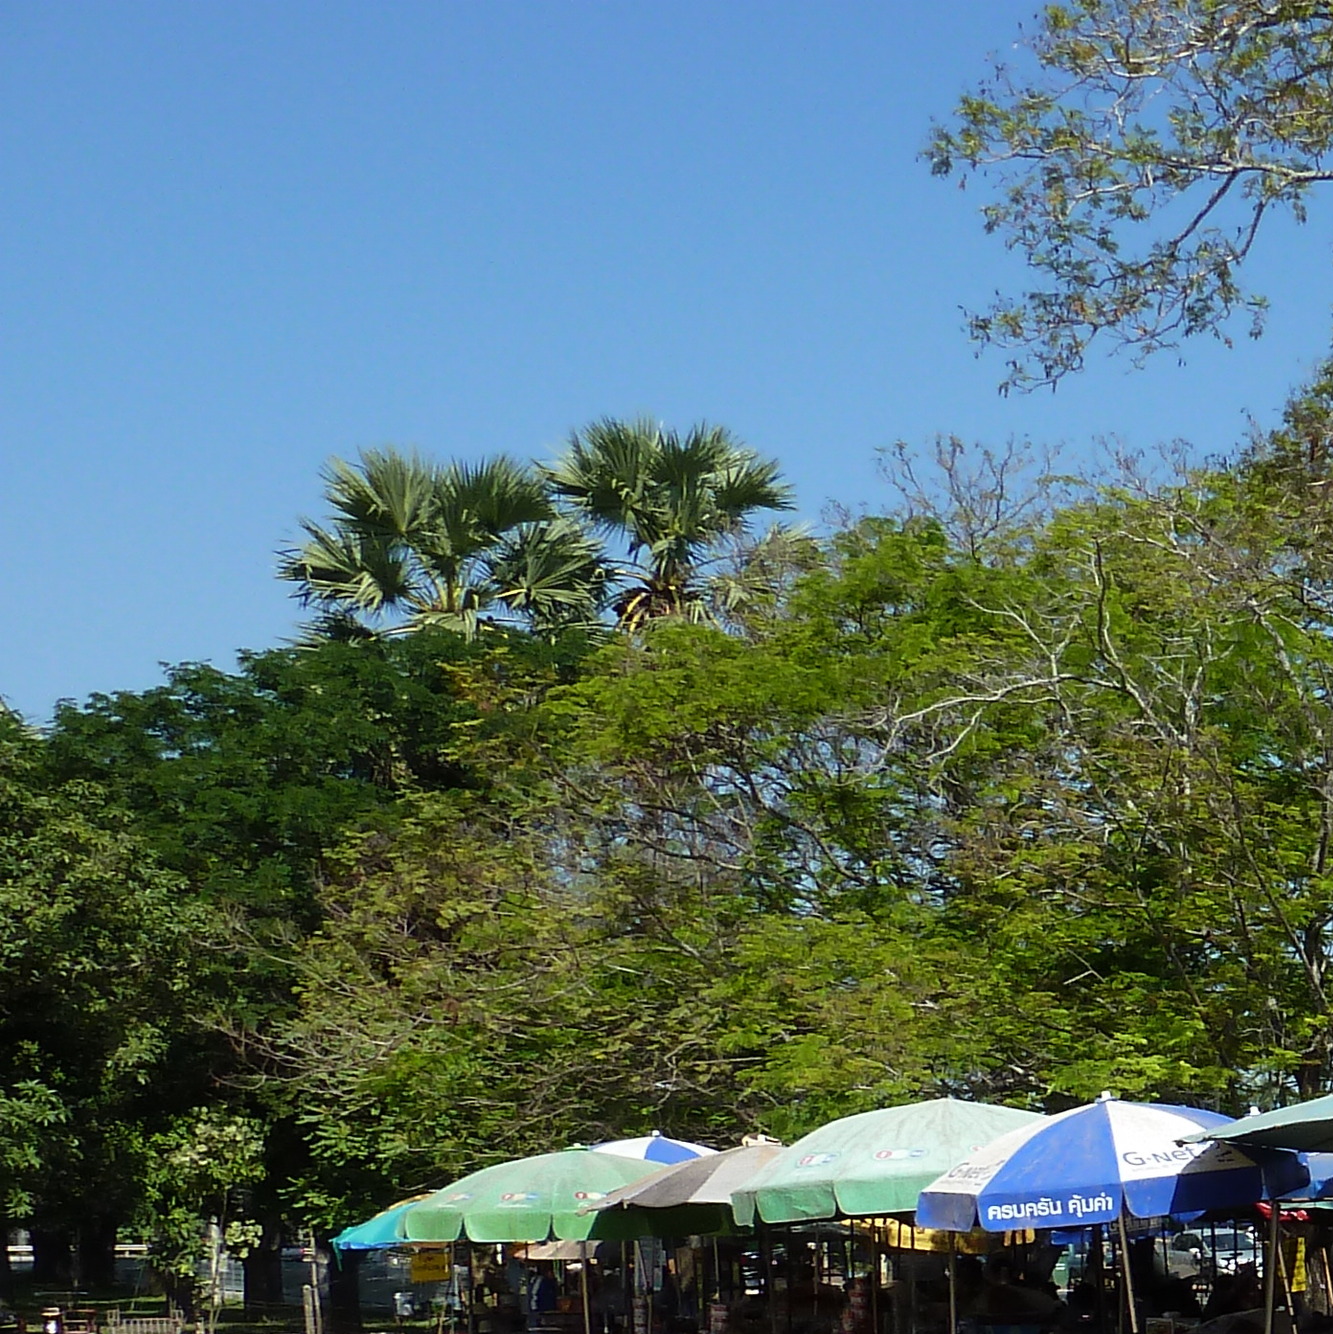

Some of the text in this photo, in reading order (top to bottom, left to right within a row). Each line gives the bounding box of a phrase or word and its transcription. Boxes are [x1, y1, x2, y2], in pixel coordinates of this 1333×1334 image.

[987, 1192, 1113, 1221] ครบครัน คุ้มค่า
